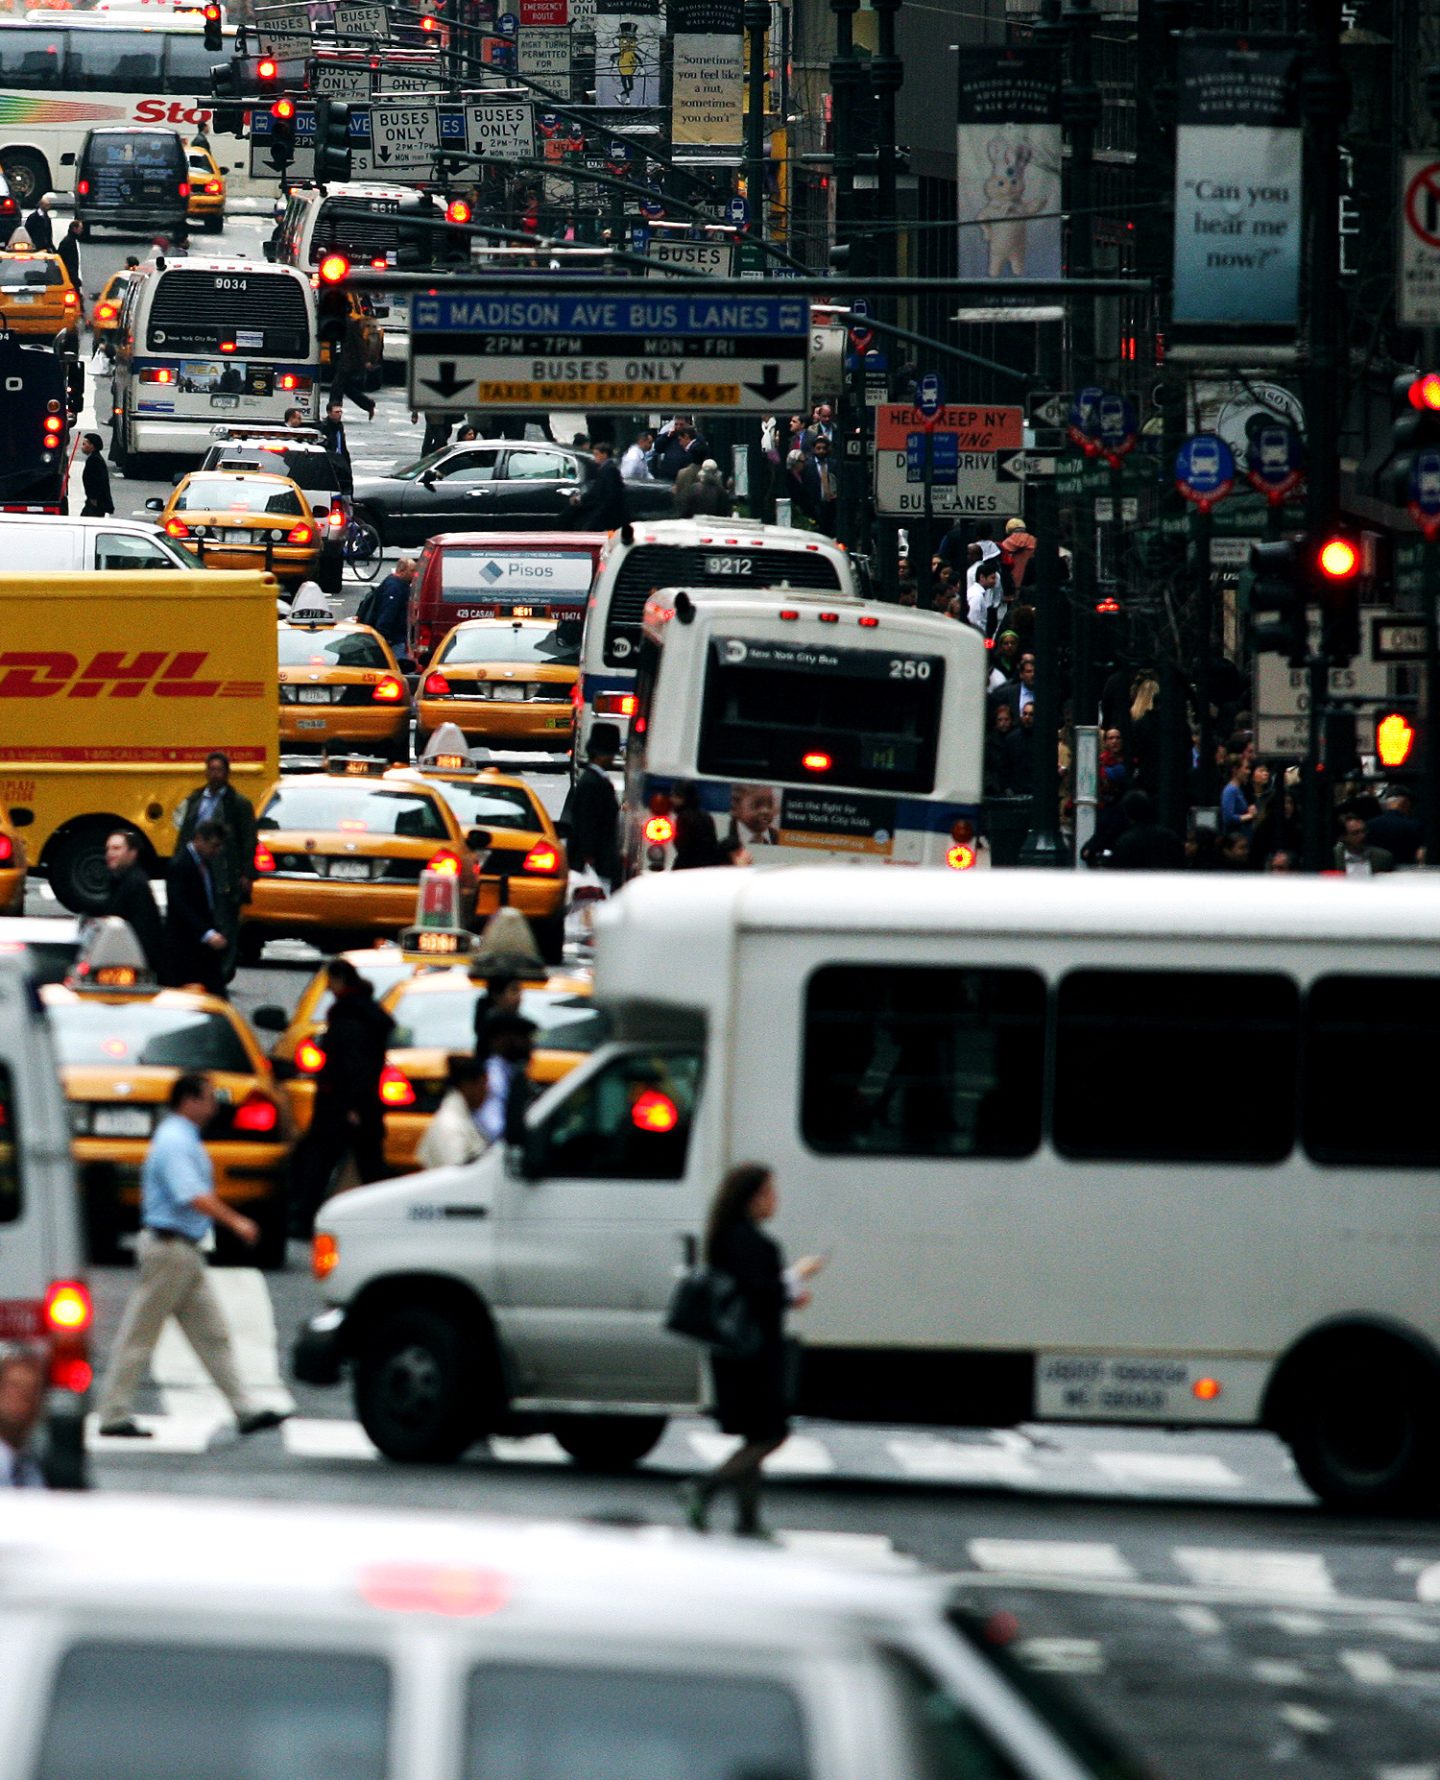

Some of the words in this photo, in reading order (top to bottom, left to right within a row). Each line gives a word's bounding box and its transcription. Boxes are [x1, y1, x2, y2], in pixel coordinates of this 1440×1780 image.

[523, 3, 563, 11] EMERGENCY
[341, 9, 380, 23] BUSES
[532, 12, 555, 20] ROUTE
[263, 18, 304, 30] BUSES
[347, 22, 378, 33] ONLY
[545, 41, 568, 49] TURNS
[536, 60, 552, 68] FOR
[678, 71, 698, 81] you
[700, 69, 720, 79] feel
[721, 69, 741, 80] like
[323, 78, 359, 89] ONLY
[392, 79, 429, 91] ONLY
[703, 85, 724, 94] nut,
[681, 98, 736, 108] sometimes
[380, 113, 429, 126] BUSES
[474, 109, 524, 122] BUSES
[681, 115, 701, 124] you
[386, 127, 426, 141] ONLY
[480, 124, 520, 138] ONLY
[396, 142, 435, 150] 2PM-7PM
[490, 138, 530, 147] 2PM-7PM
[395, 154, 409, 162] MON
[1247, 184, 1290, 206] you
[1194, 212, 1246, 236] hear
[1252, 220, 1287, 236] me
[658, 249, 721, 264] BUSES
[215, 278, 247, 291] 9034
[450, 303, 559, 327] MADISON
[571, 305, 617, 327] AVE
[630, 307, 677, 328] BUS
[689, 307, 769, 330] LANES
[485, 338, 524, 355] 2PM
[543, 338, 582, 355] 7PM
[644, 339, 682, 355] MON
[703, 340, 735, 355] FRI
[532, 361, 609, 381] BUSES
[625, 362, 685, 381] ONLY
[483, 384, 534, 400] TAXIS
[541, 384, 588, 401] MUST
[596, 385, 632, 401] EXIT
[640, 385, 662, 401] AT
[671, 385, 679, 401] E
[686, 385, 710, 401] 46
[719, 386, 738, 402] ST
[890, 411, 922, 424] HEL
[944, 412, 978, 427] KEEP
[984, 412, 1007, 427] NY
[1012, 456, 1041, 471] ONE
[508, 562, 554, 578] Pisos
[708, 556, 752, 575] 9212
[470, 610, 495, 618] CASAN
[796, 651, 817, 666] City
[818, 653, 839, 666] Bus
[889, 659, 930, 680] 250
